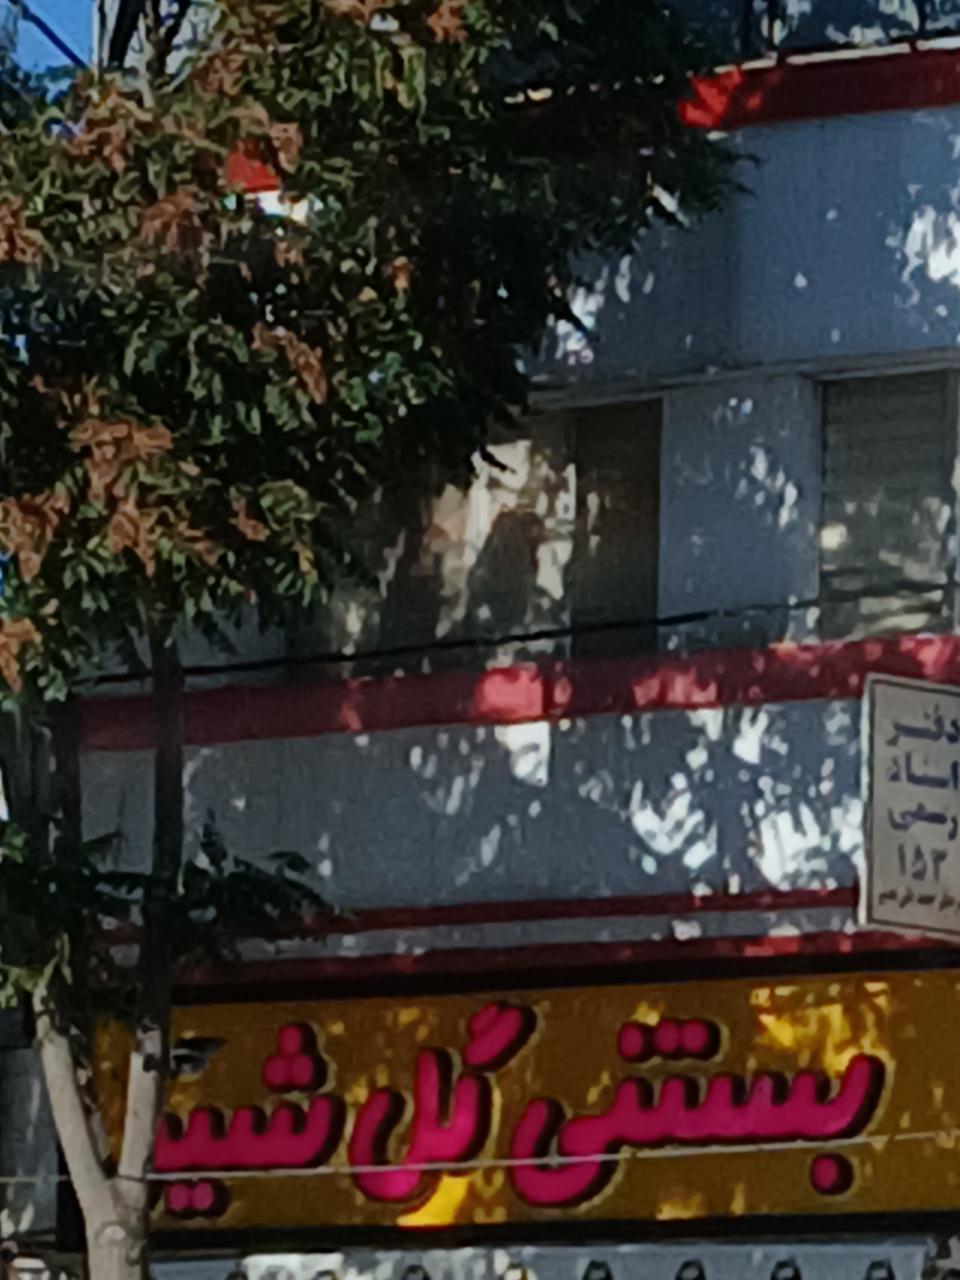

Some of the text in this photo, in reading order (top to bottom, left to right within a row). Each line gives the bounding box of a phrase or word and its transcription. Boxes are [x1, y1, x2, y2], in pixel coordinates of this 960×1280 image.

[885, 704, 960, 746] دفتر
[888, 752, 960, 792] اسناد
[887, 802, 959, 841] رسمی
[510, 1017, 887, 1207] بستنی
